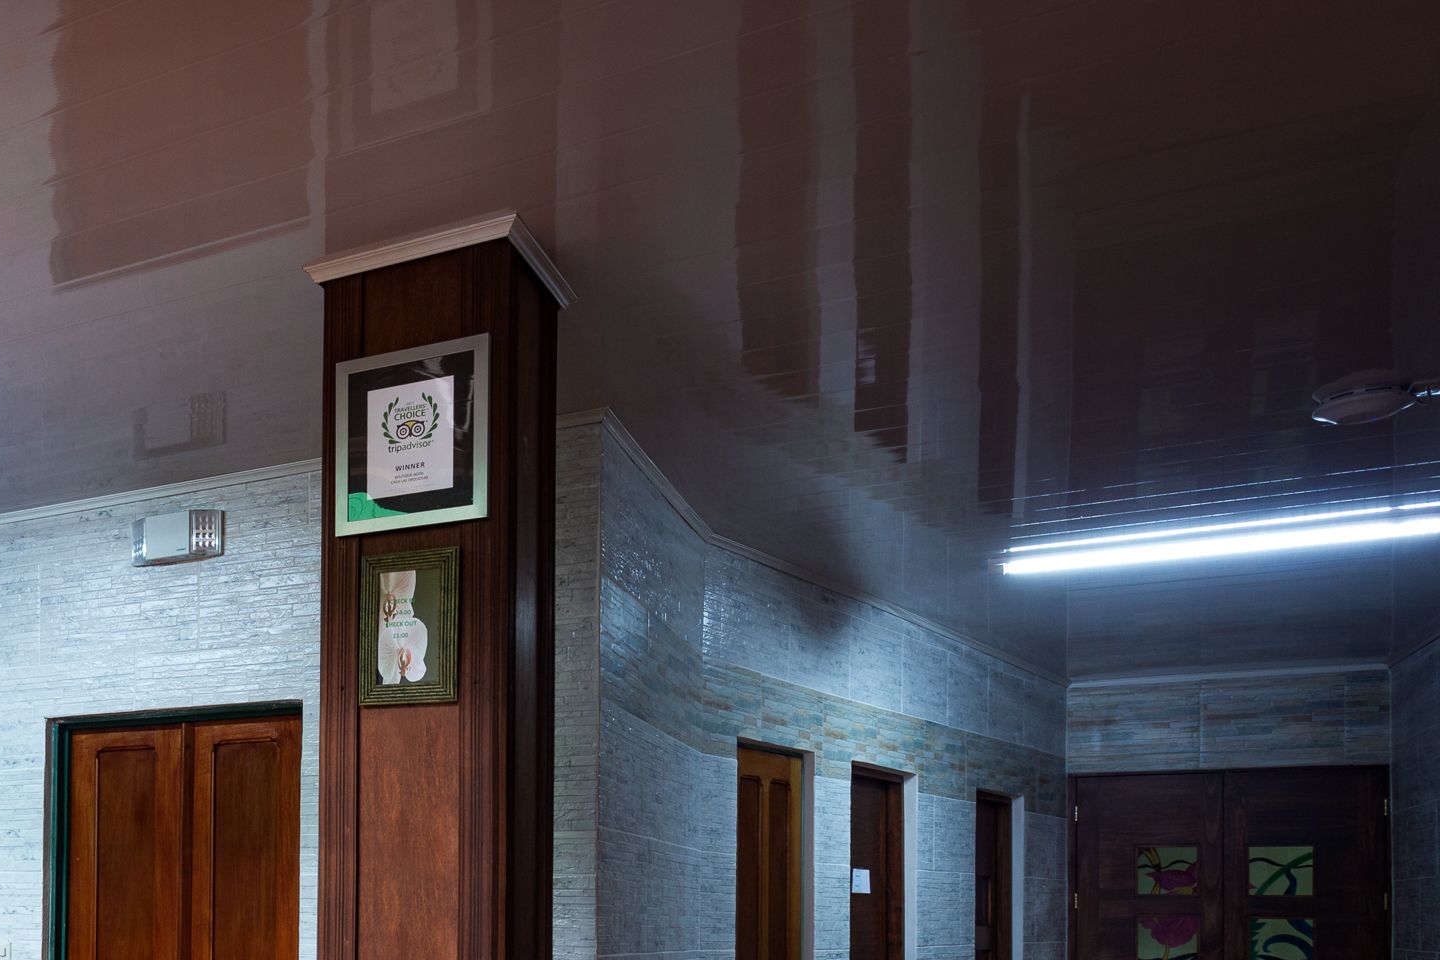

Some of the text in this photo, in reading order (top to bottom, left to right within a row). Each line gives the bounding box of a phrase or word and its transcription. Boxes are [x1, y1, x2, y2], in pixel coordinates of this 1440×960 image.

[394, 410, 426, 421] CHOICE
[388, 441, 431, 453] tripadvisor
[395, 462, 425, 471] WINNER
